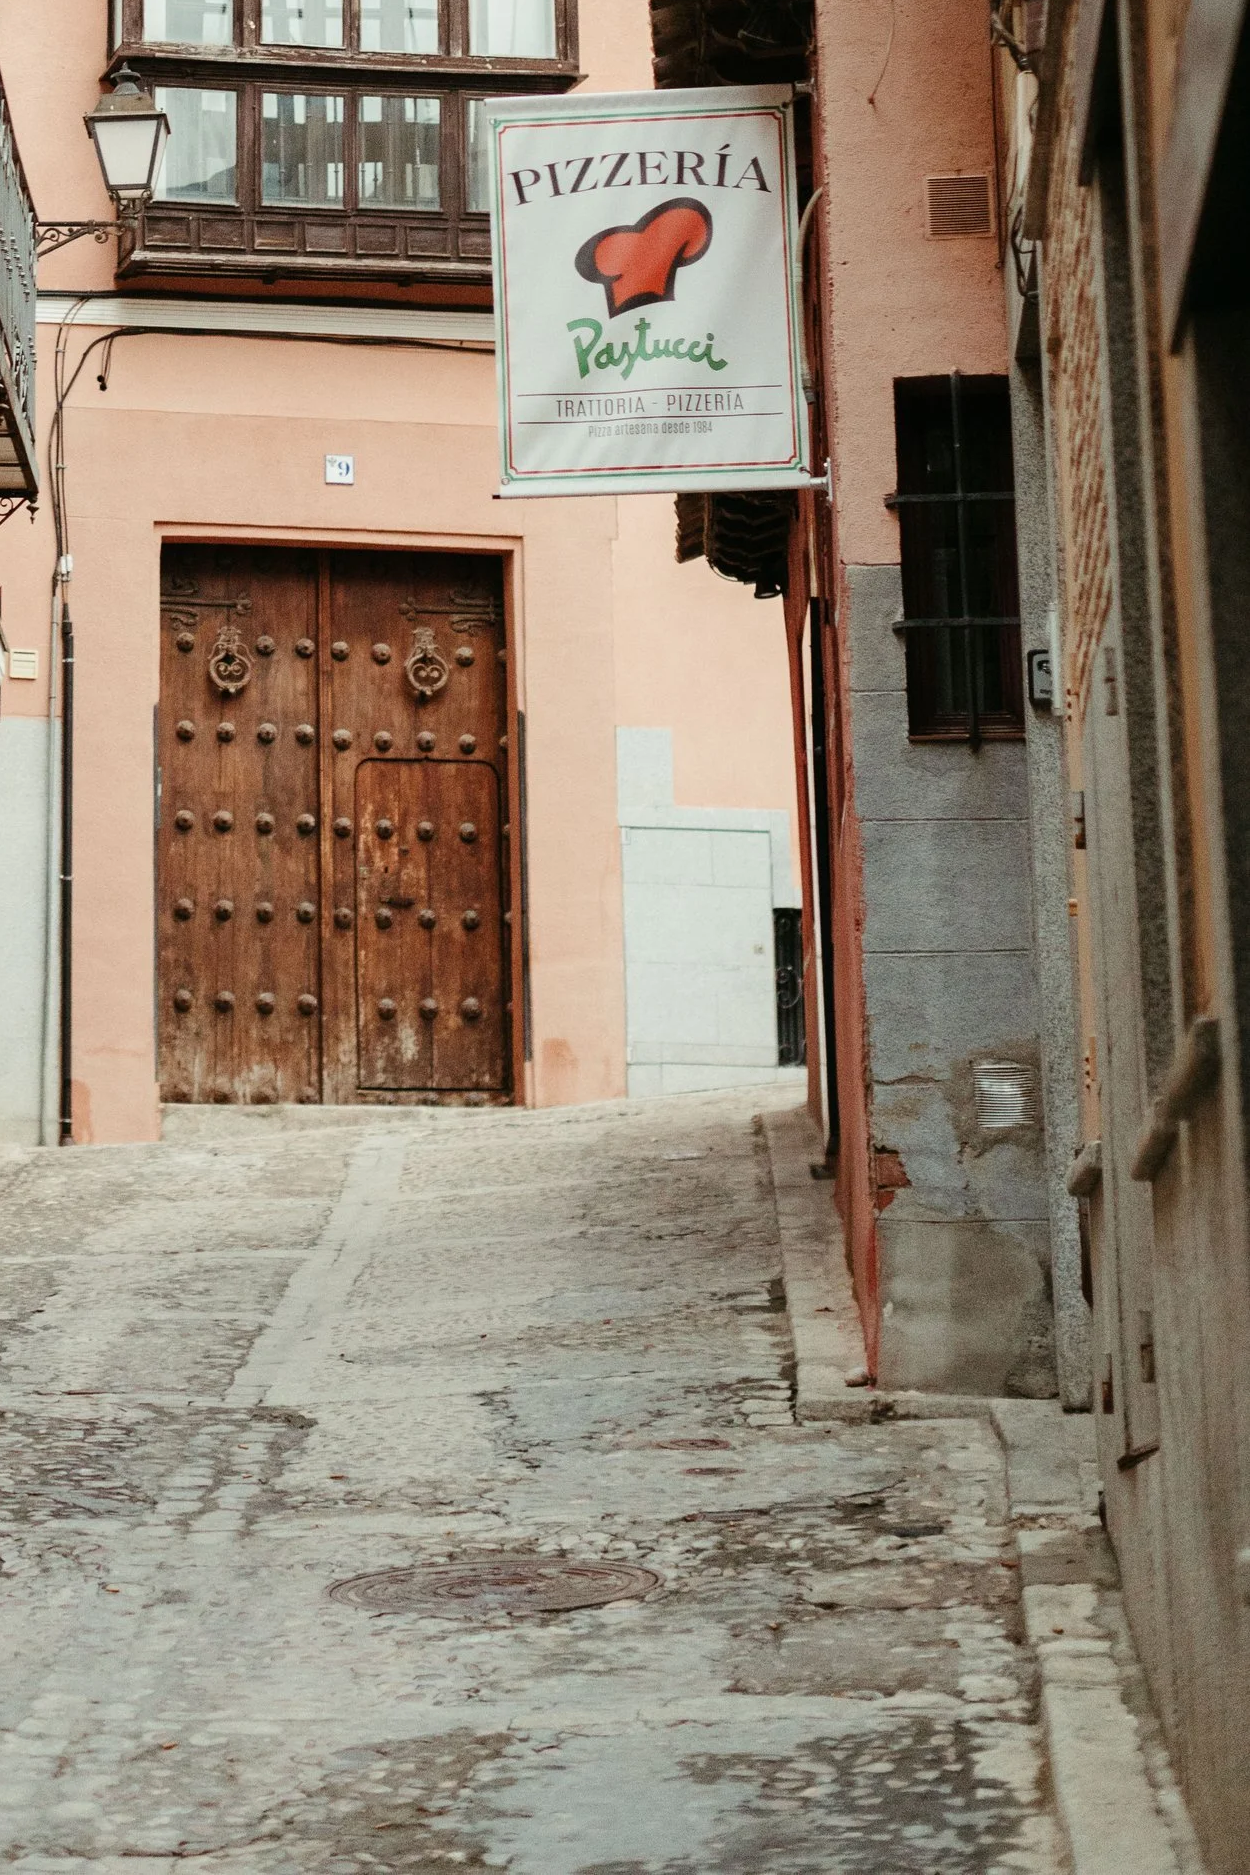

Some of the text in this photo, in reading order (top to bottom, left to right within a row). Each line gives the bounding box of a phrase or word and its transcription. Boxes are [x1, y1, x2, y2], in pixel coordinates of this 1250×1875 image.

[507, 143, 772, 206] PIZZERÍA
[566, 317, 729, 381] Pastucci
[555, 396, 646, 418] TRATTORIA
[666, 390, 745, 413] PIZZERÍA
[588, 425, 612, 438] Pizza
[614, 422, 659, 436] artesana
[661, 421, 690, 435] desde
[337, 461, 351, 477] 9
